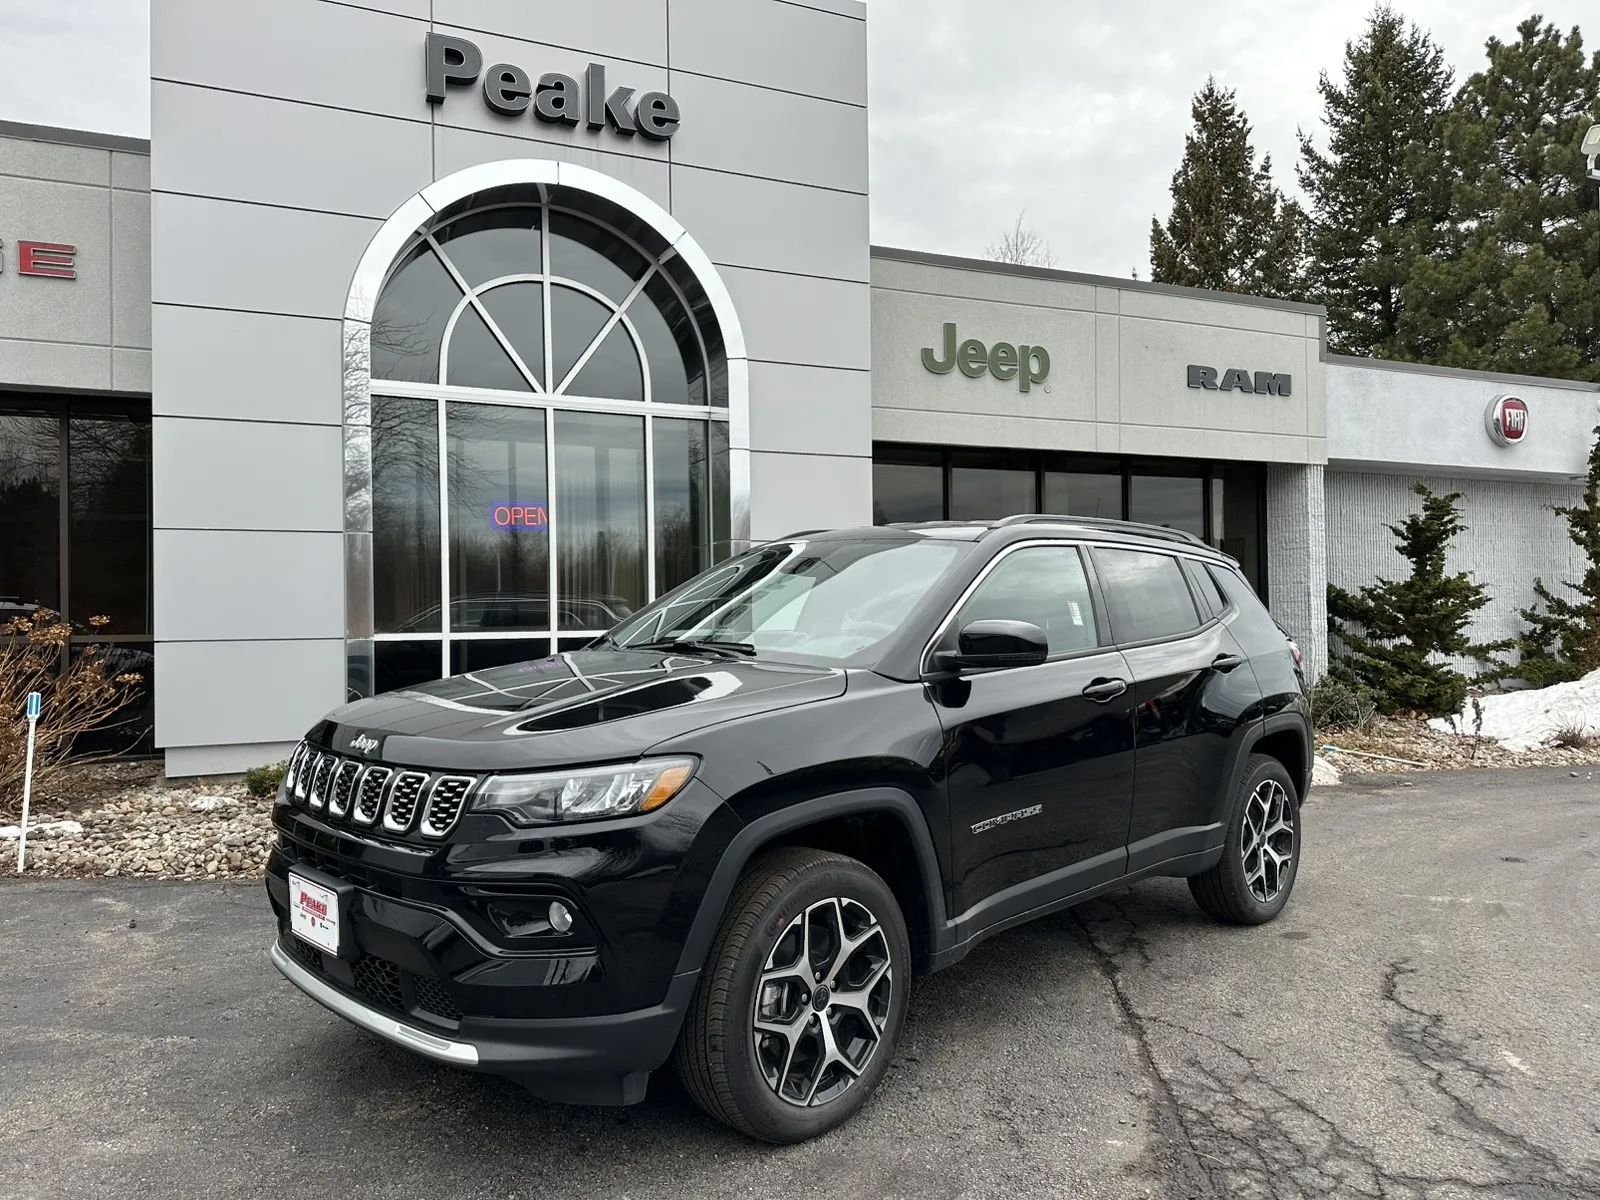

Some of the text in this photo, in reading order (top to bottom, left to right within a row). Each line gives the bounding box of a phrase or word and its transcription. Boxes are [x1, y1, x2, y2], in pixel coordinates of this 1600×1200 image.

[425, 31, 681, 142] Peake
[0, 238, 76, 280] E
[920, 322, 1051, 393] Jeep
[1187, 364, 1292, 396] RAM
[1504, 408, 1525, 431] FIAT
[494, 506, 548, 526] OPEN
